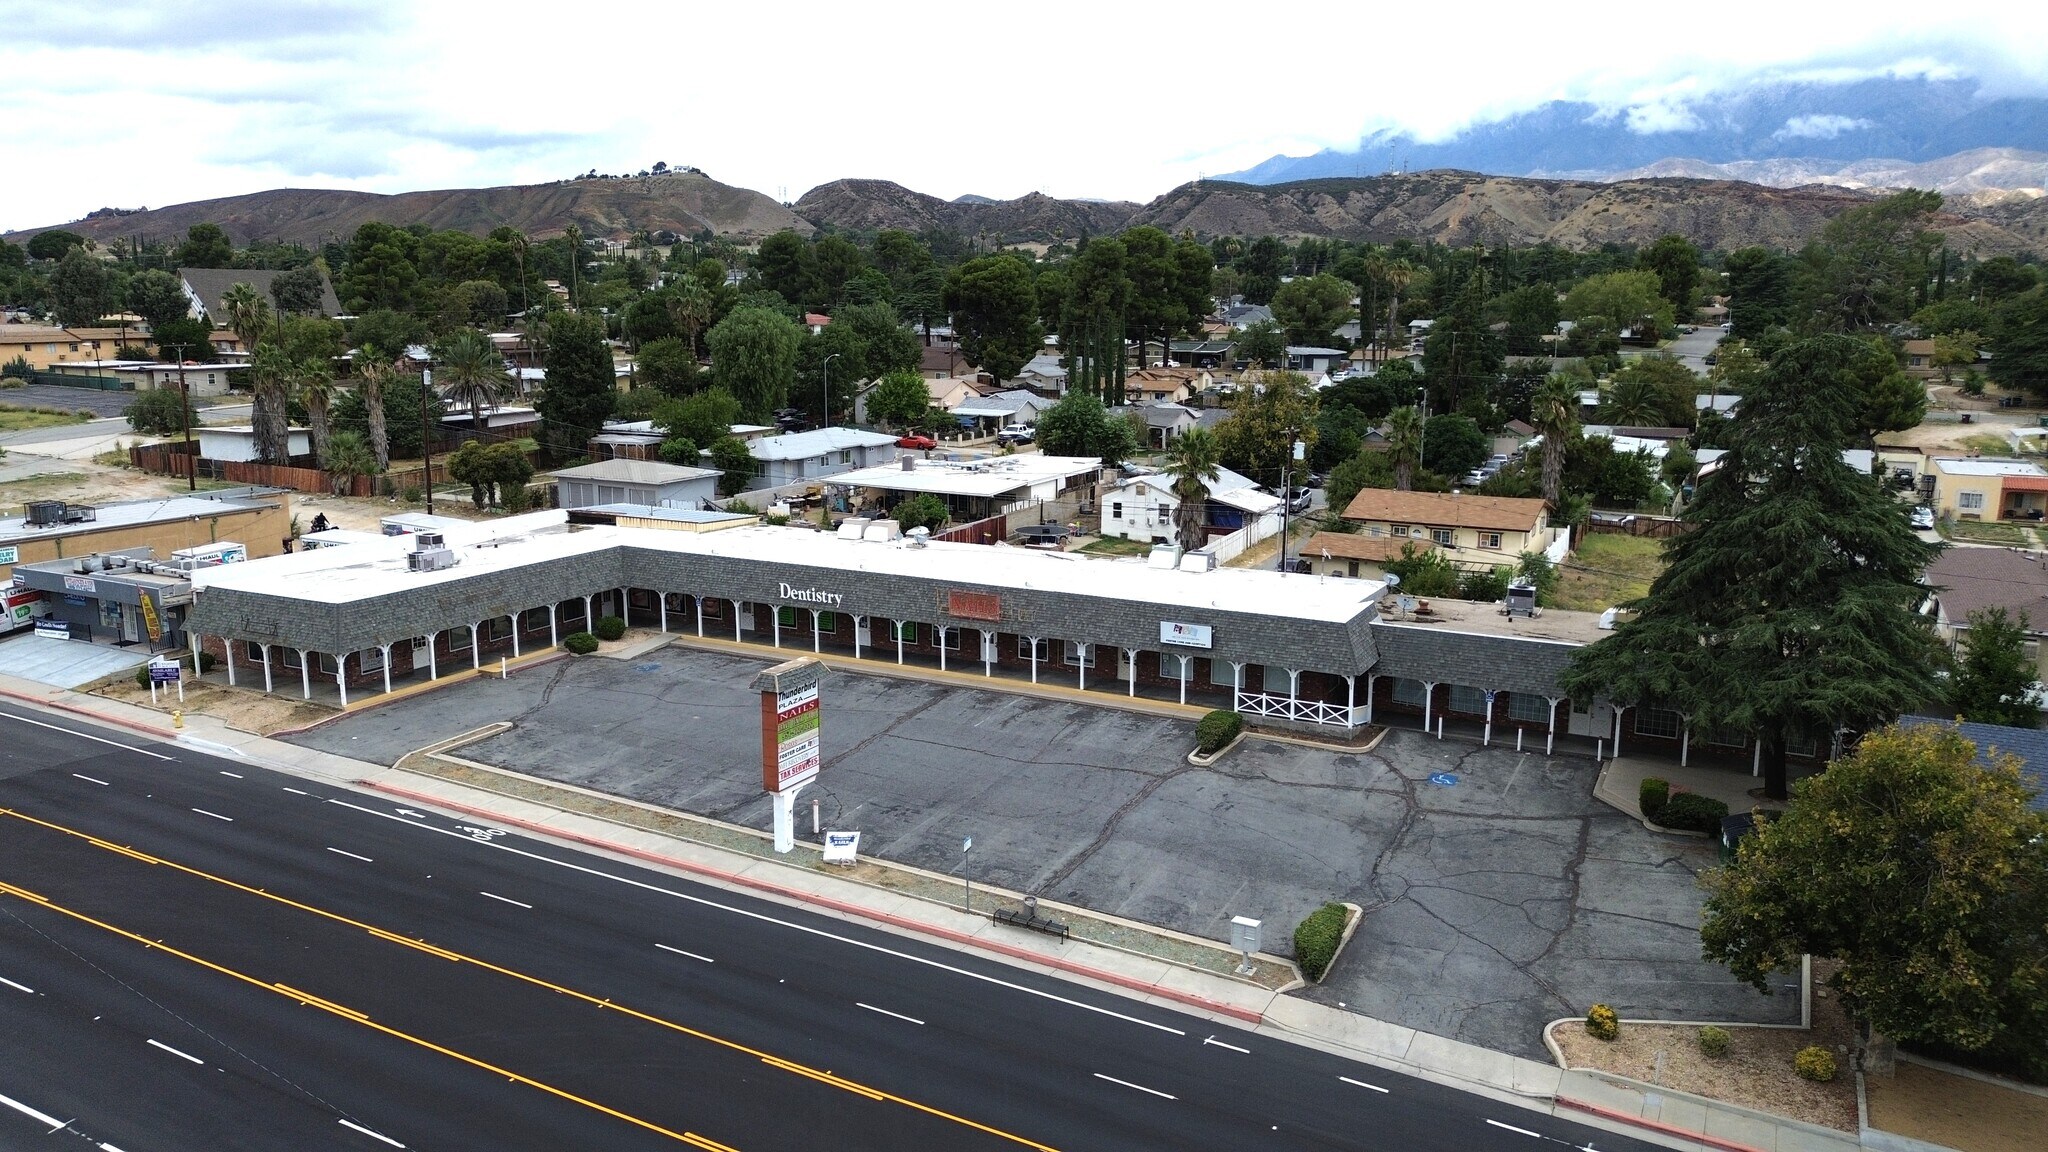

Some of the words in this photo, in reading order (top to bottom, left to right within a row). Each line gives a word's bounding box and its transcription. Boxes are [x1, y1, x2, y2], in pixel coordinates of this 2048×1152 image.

[779, 582, 843, 608] Dentistry
[779, 679, 817, 702] Thunderbird
[779, 696, 803, 709] PLAZA
[780, 701, 815, 721] NAILS
[780, 749, 795, 760] FOSTER
[796, 744, 807, 753] CARE
[780, 770, 791, 780] TAX
[791, 757, 818, 775] SERVICES
